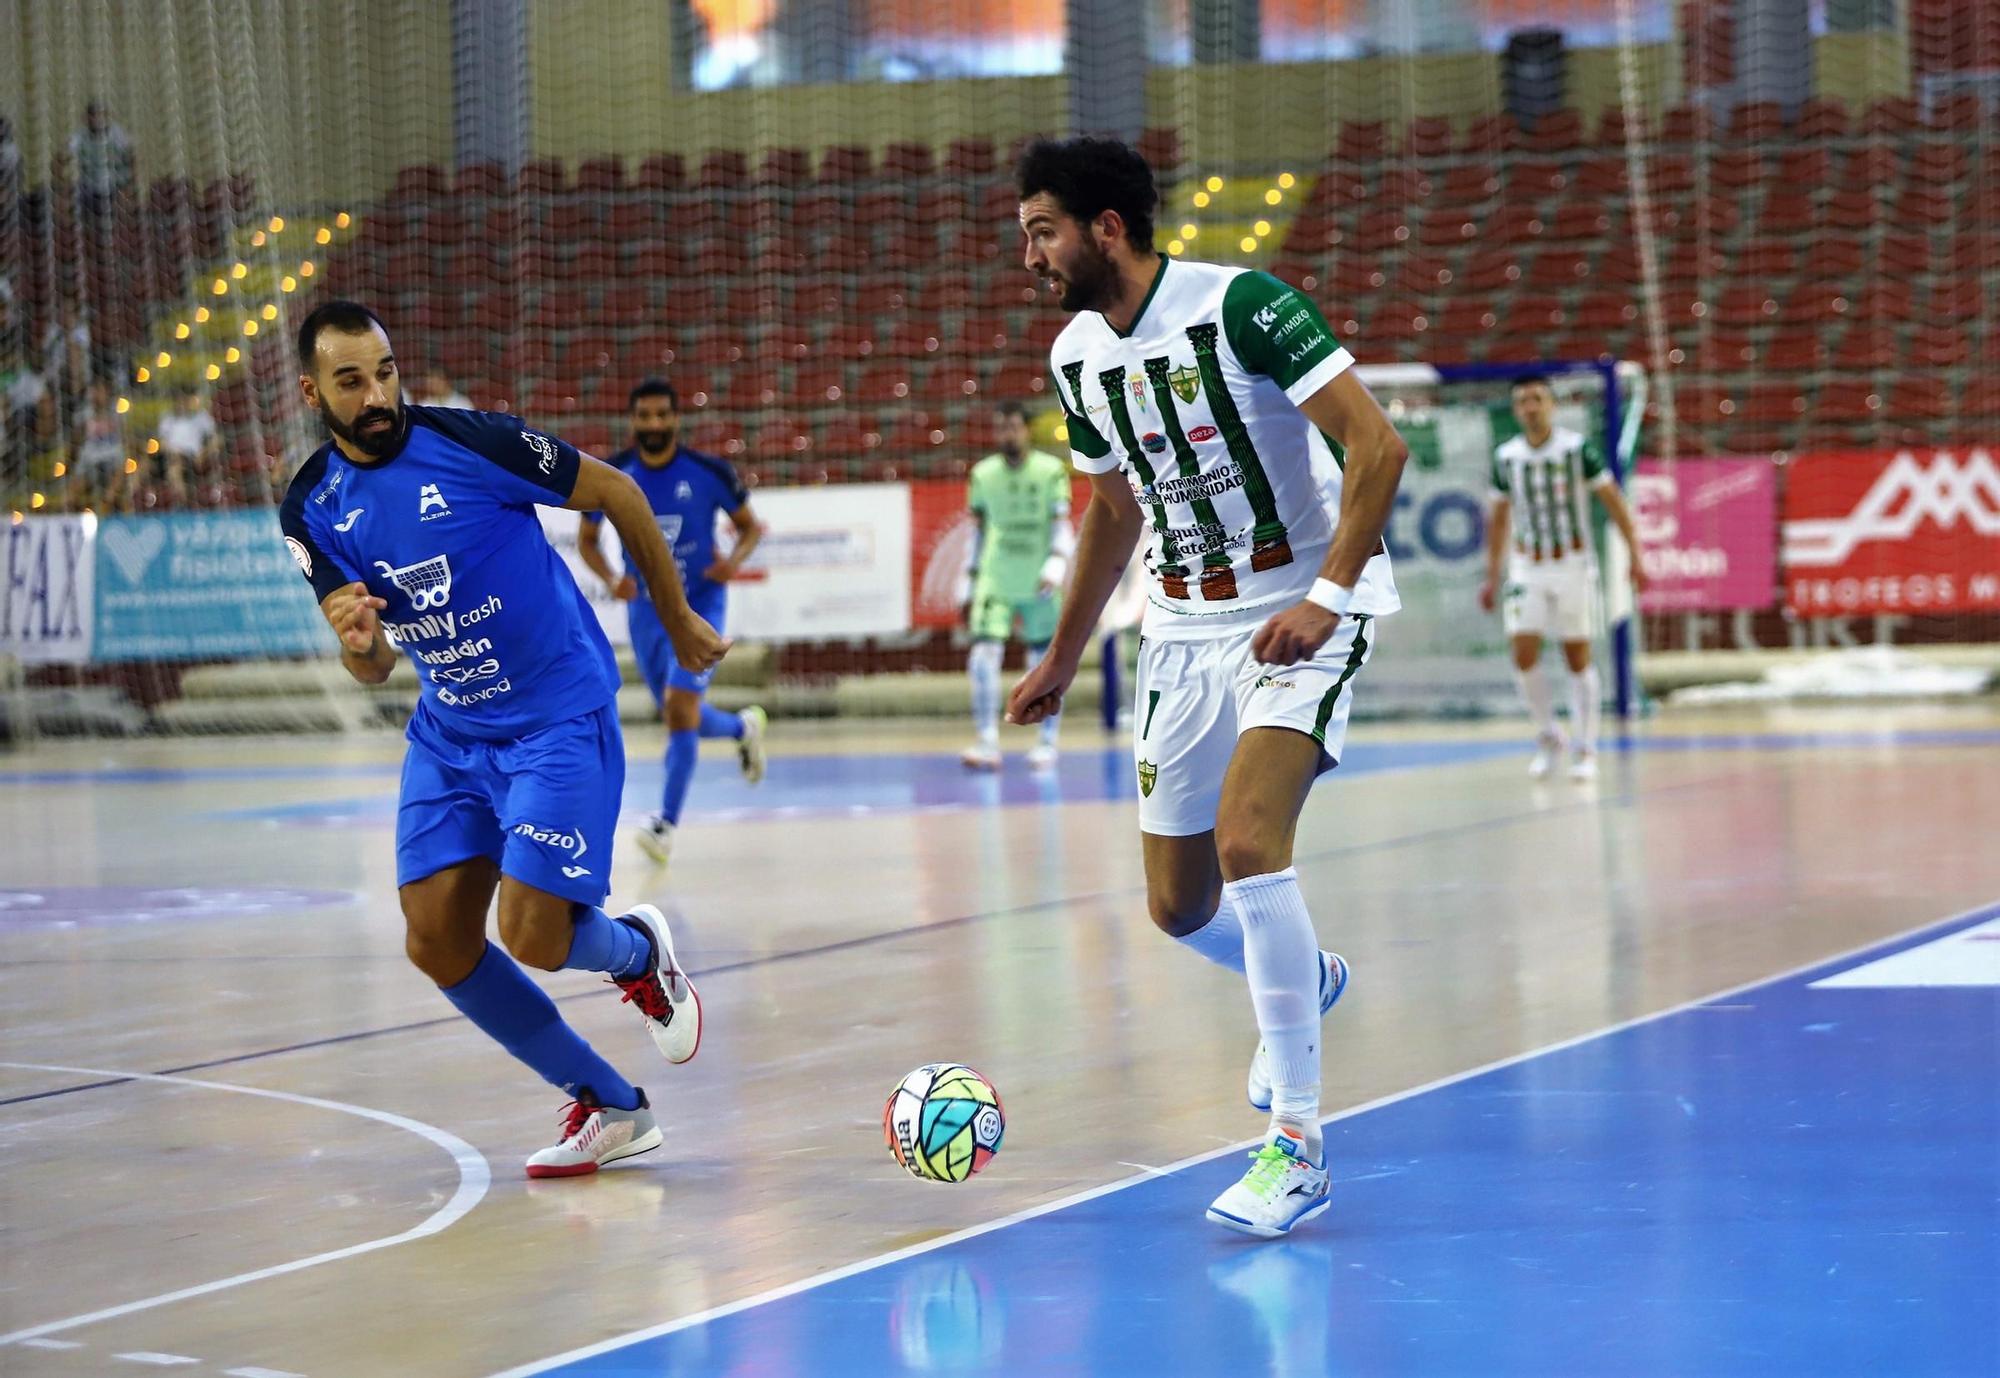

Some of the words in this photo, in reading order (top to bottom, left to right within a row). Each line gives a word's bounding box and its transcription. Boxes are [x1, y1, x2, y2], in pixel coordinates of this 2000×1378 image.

[1158, 465, 1230, 493] PATRIMONIO
[1163, 474, 1246, 505] HUMANIDAD
[460, 595, 503, 627] cash
